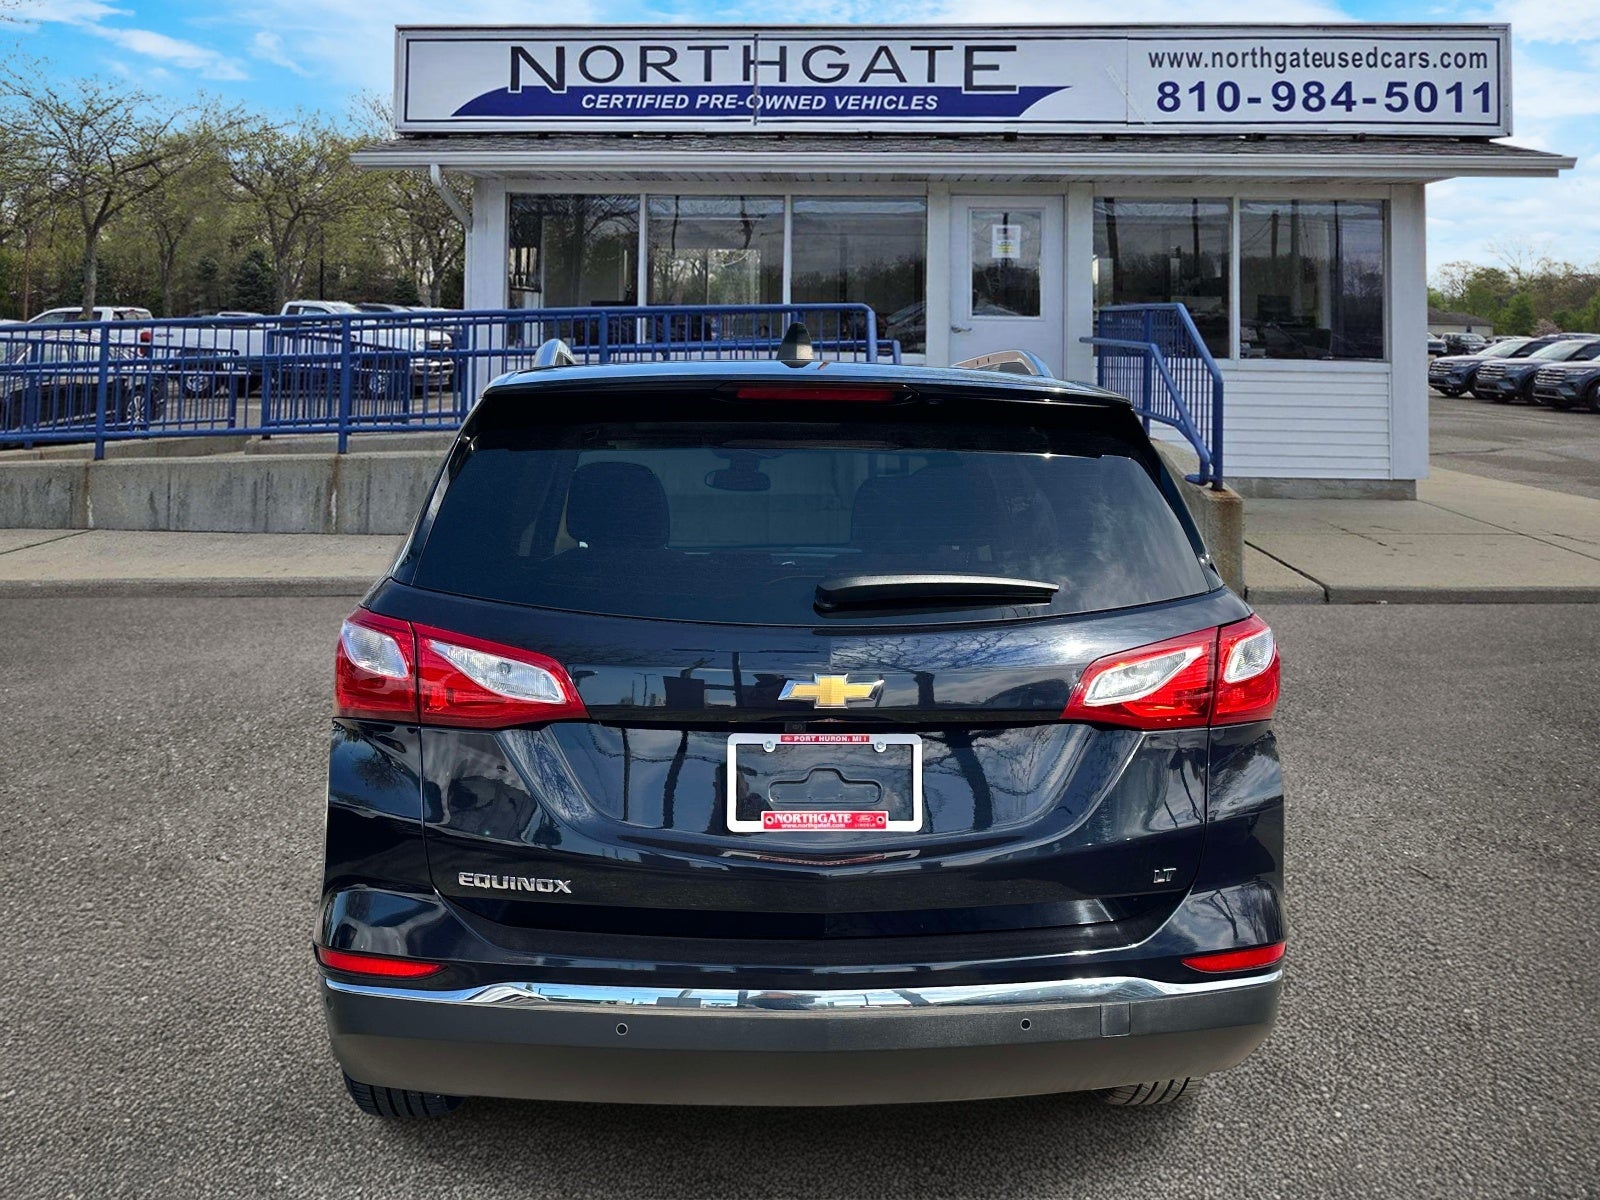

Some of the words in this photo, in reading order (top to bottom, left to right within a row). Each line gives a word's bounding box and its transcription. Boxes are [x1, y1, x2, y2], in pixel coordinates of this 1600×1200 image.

[509, 45, 1017, 92] NORTHGATE
[1149, 46, 1489, 73] www.northgateusedcars.com
[581, 94, 690, 110] CERTIFIED
[695, 94, 828, 110] PRE-OWNED
[834, 95, 939, 111] VEHICLES
[1156, 80, 1491, 113] 810-984-5011
[774, 813, 853, 823] NORTHGATE
[458, 871, 572, 894] EQUINOX
[1153, 867, 1177, 883] LT
